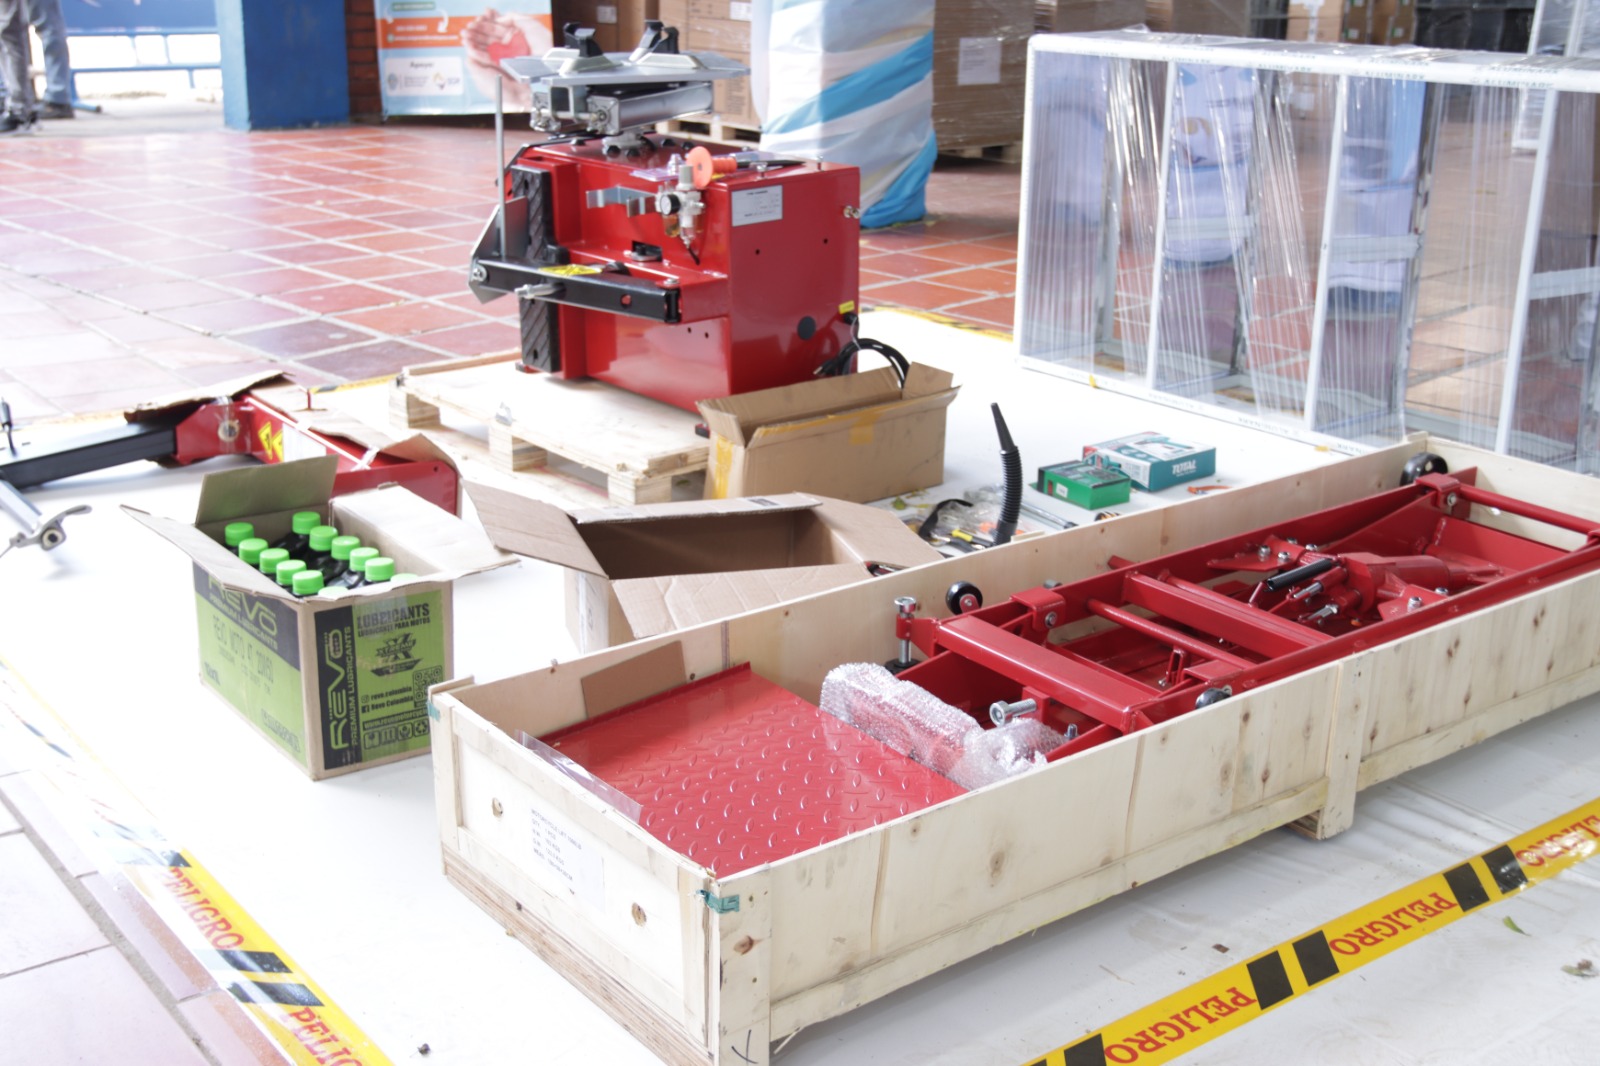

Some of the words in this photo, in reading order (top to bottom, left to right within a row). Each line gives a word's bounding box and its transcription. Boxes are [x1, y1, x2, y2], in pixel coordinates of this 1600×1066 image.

[1172, 459, 1197, 475] TOTAL
[357, 603, 430, 629] LUBRICANTS
[395, 621, 410, 630] PARA
[344, 626, 355, 694] LUBRICANTS
[325, 629, 349, 750] REVO
[349, 696, 359, 746] PREMIUM
[1329, 892, 1459, 955] PELIGRO
[1104, 987, 1258, 1064] PELIGRO
